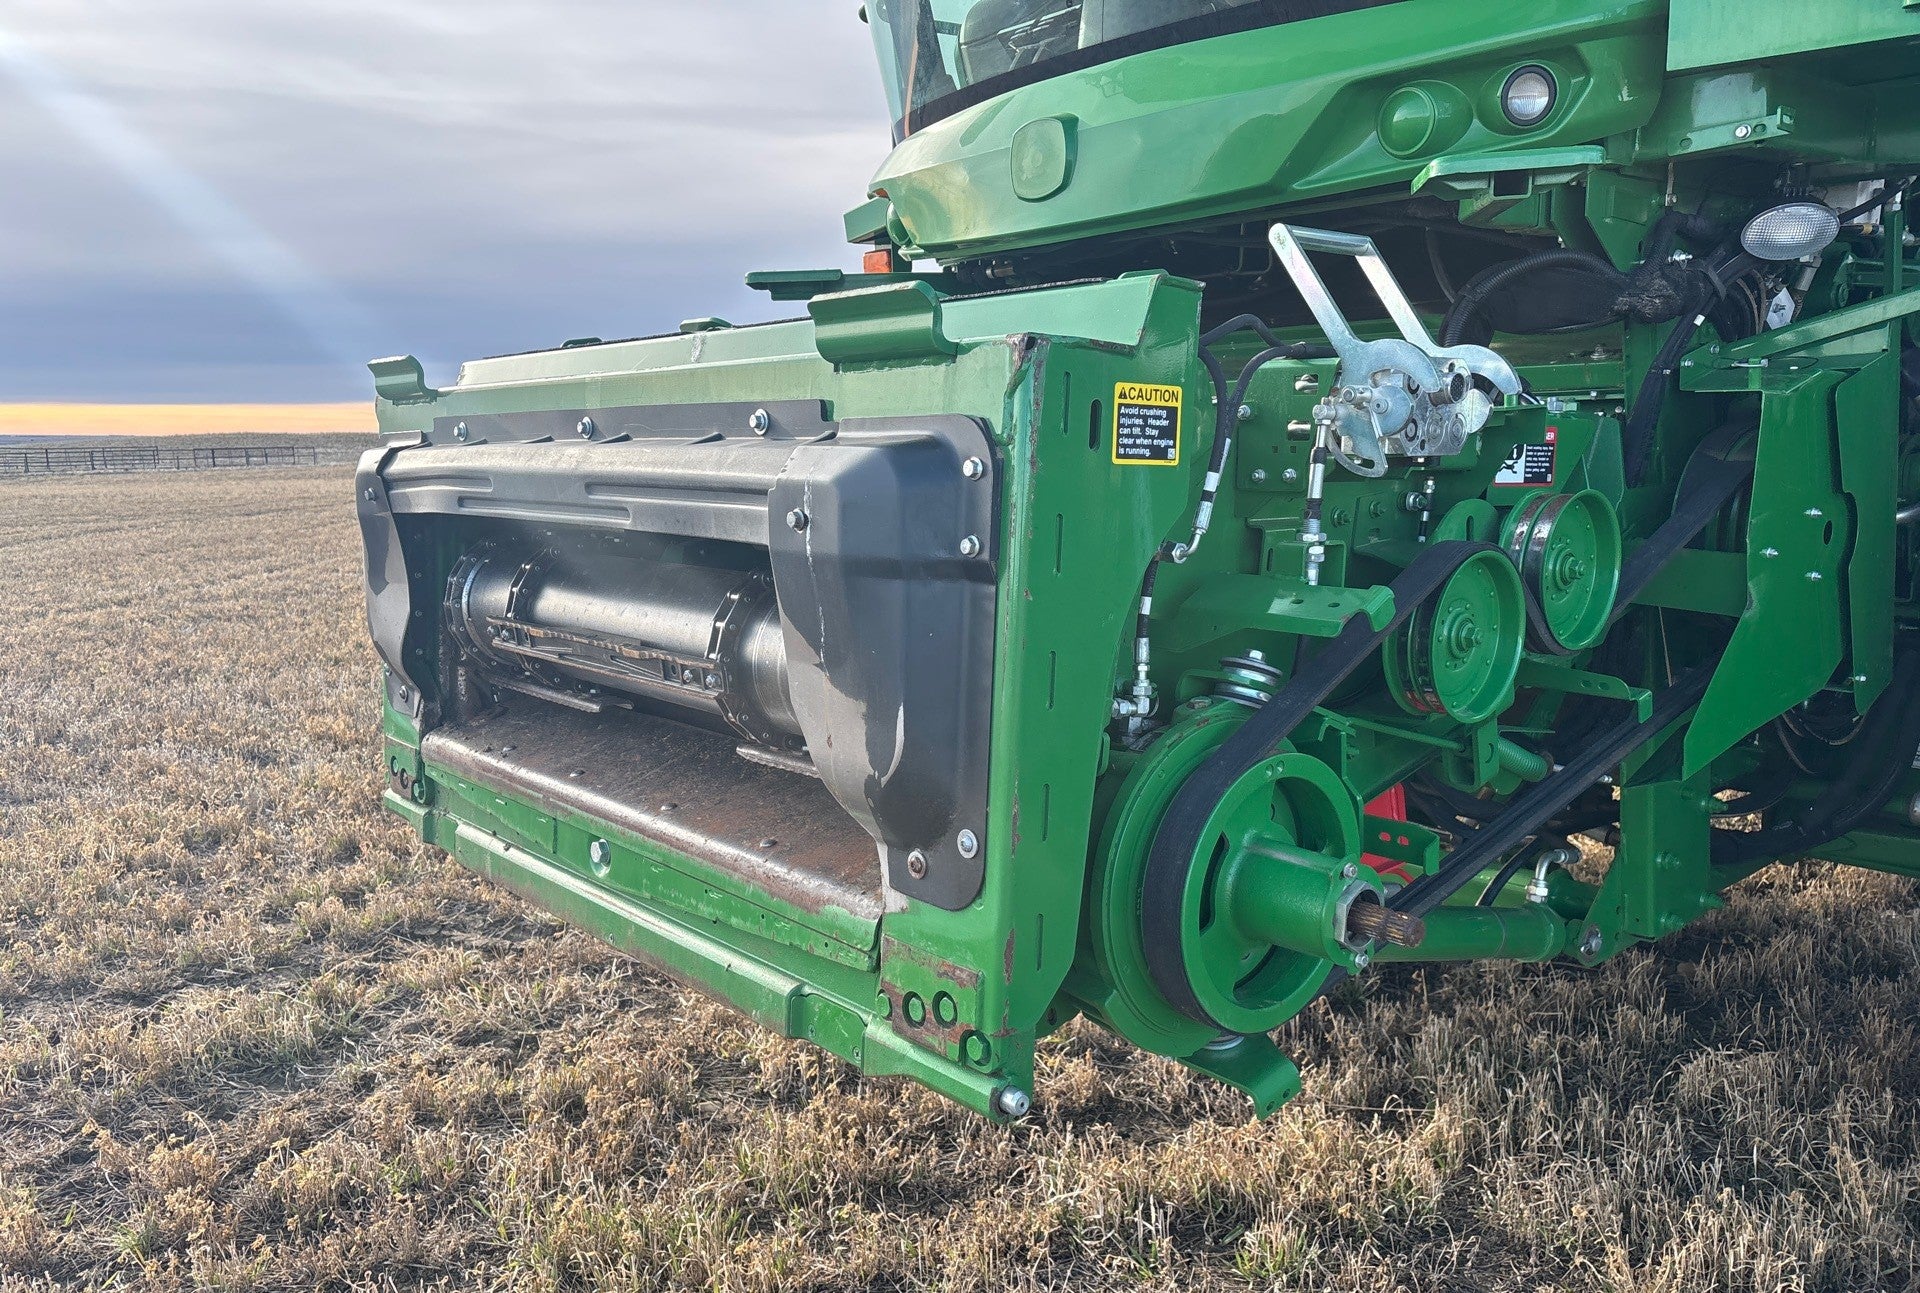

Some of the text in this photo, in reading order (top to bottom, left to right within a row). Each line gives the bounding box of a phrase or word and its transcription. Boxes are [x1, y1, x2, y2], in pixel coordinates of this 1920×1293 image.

[1128, 387, 1179, 403] CAUTION
[1120, 406, 1167, 418] Avoid crushing
[1119, 417, 1169, 426] injuries. Header
[1119, 427, 1131, 435] can
[1145, 427, 1159, 437] Stay
[1118, 437, 1173, 447] clear when engine
[1126, 447, 1151, 457] running.
